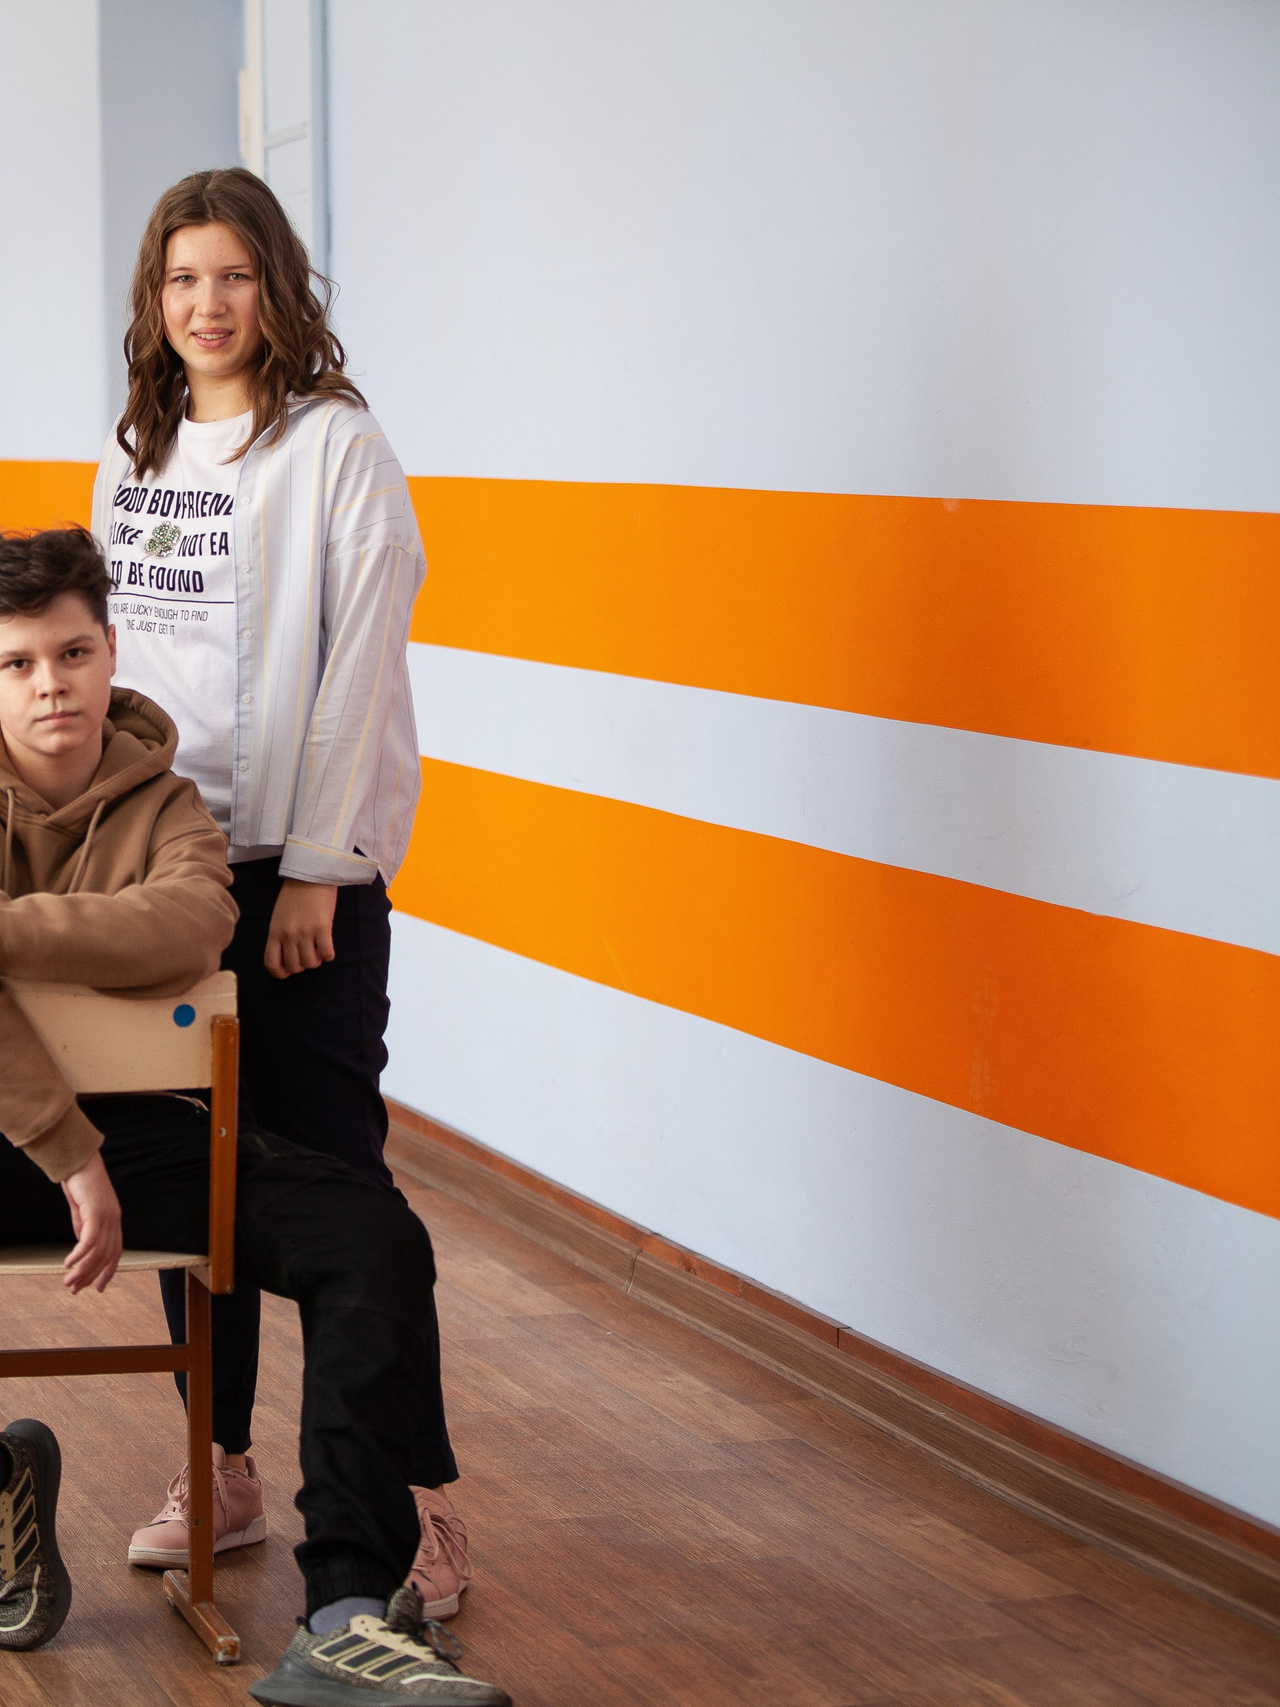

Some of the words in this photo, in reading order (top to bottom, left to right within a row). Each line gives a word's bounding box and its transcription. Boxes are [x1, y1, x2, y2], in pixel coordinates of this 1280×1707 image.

[177, 533, 206, 557] NOT
[111, 561, 122, 585] TO
[127, 562, 145, 587] BE
[149, 565, 204, 593] FOUND
[130, 603, 154, 616] LUCKY
[181, 609, 190, 621] TO
[191, 610, 208, 622] FIND
[136, 620, 157, 633] JUST
[158, 623, 168, 635] GET
